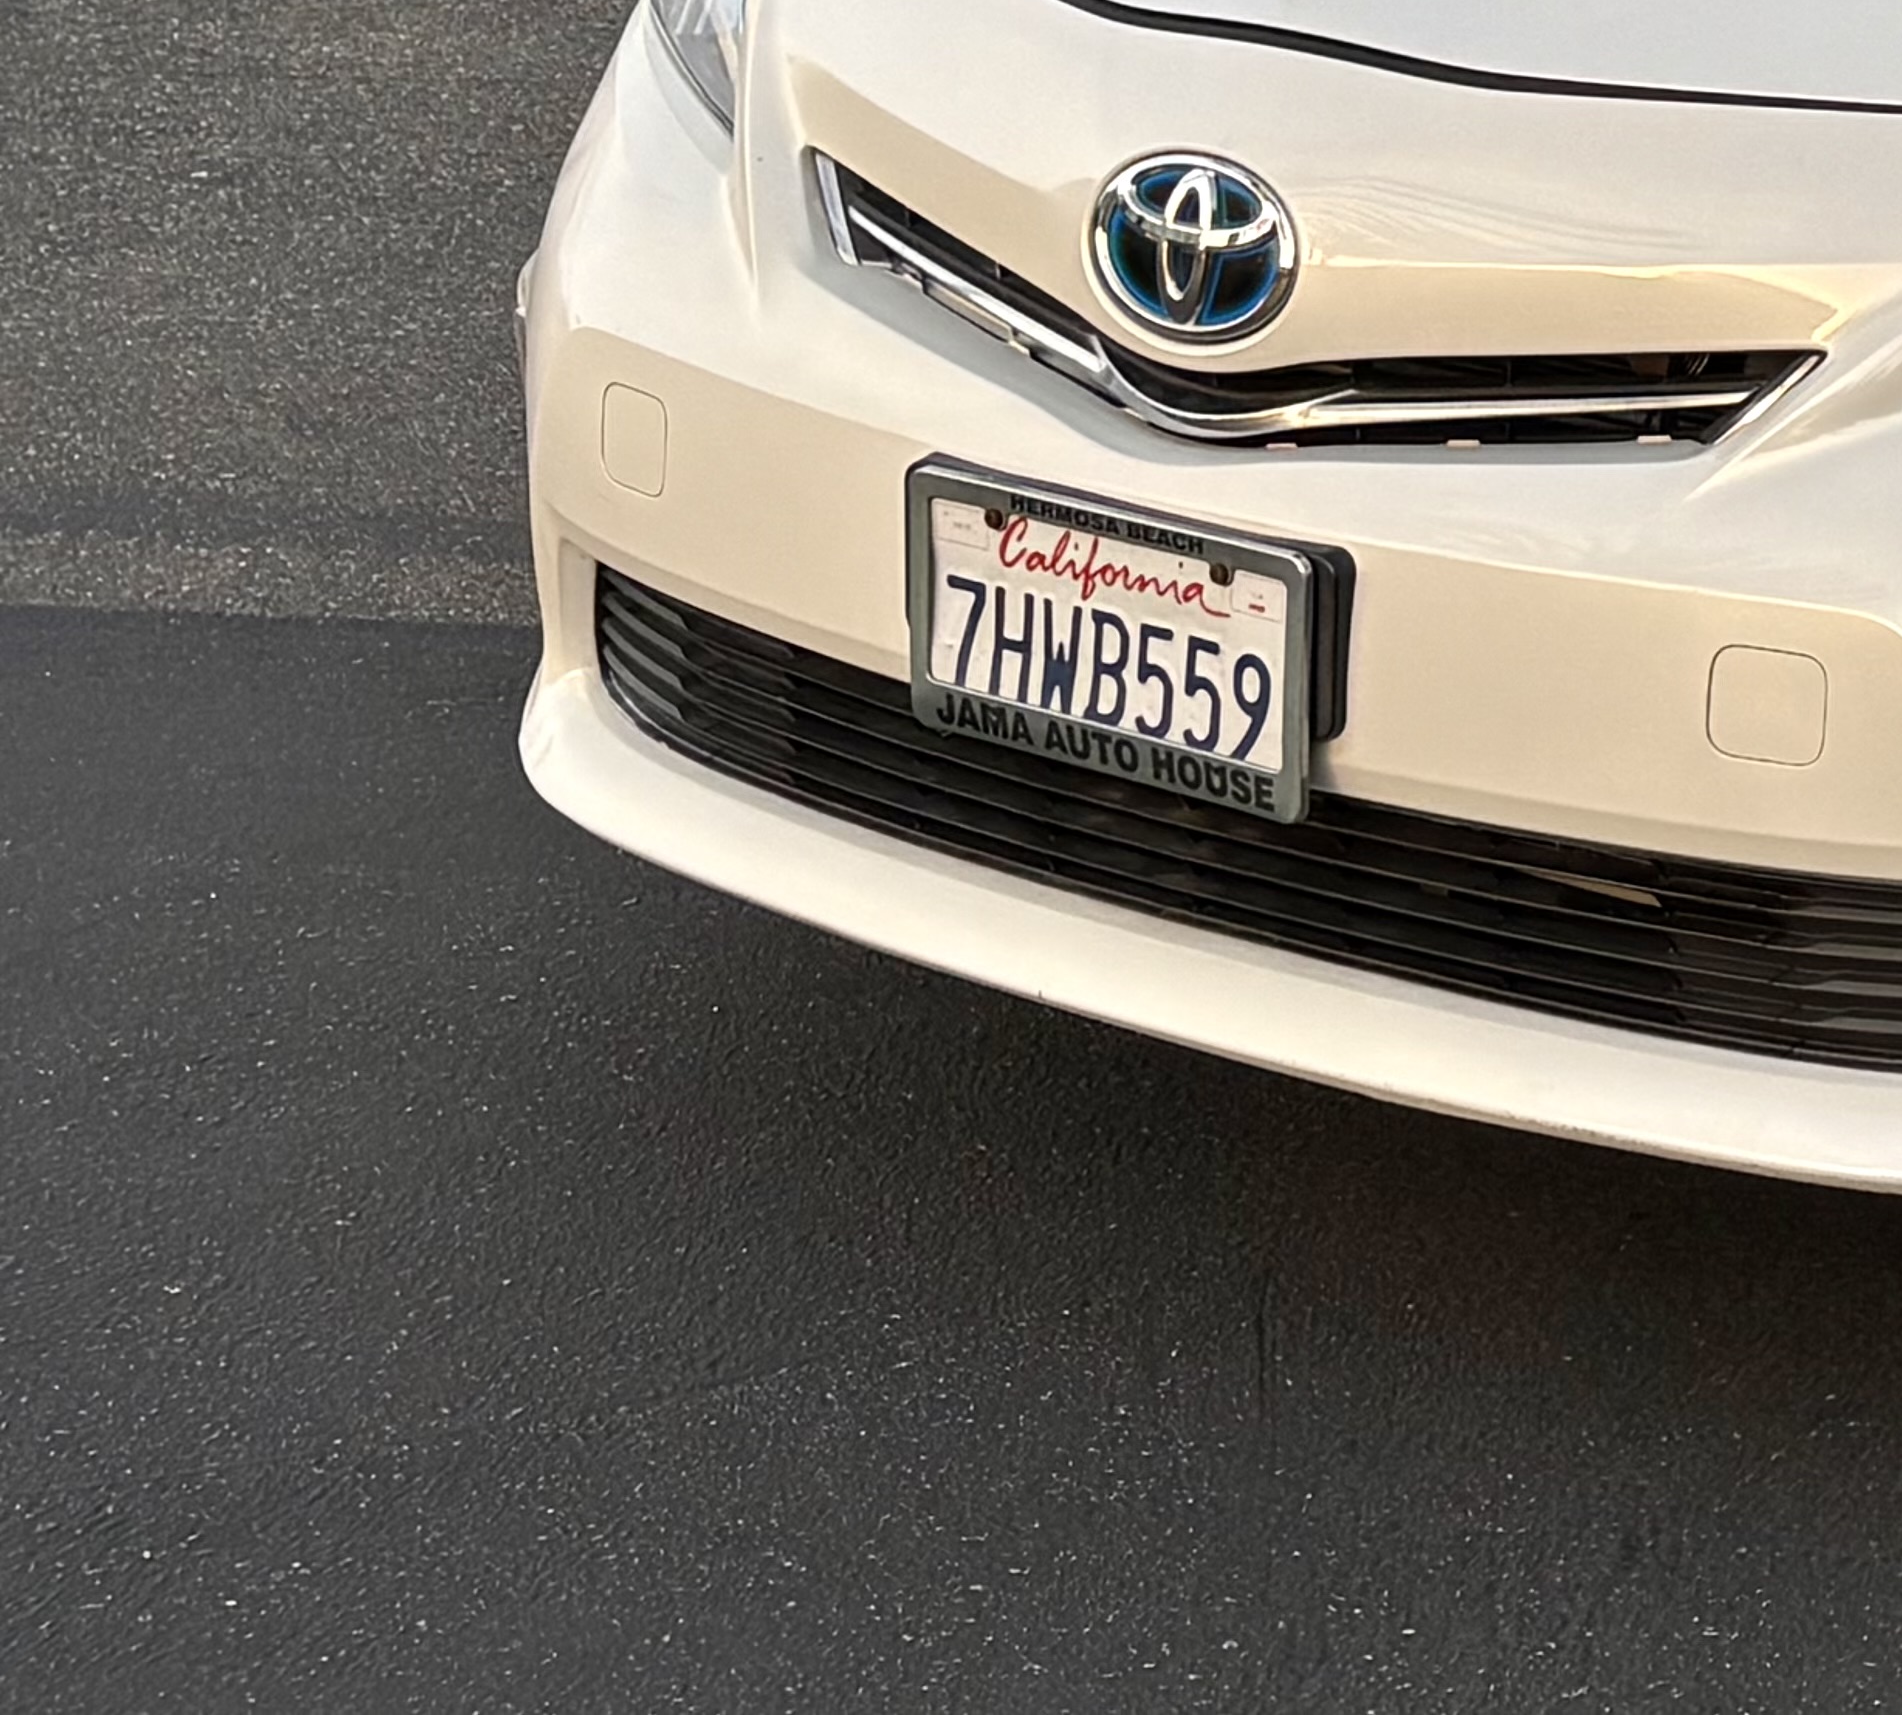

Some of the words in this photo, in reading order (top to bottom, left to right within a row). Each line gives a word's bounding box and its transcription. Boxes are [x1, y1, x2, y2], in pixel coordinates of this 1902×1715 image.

[998, 515, 1232, 619] California
[1009, 493, 1121, 536] HERMOSA
[1126, 520, 1206, 555] BEACH
[946, 573, 1272, 763] 7HWB559
[936, 692, 1035, 746] JAMA
[1045, 719, 1139, 774] AUTO
[1151, 746, 1276, 813] HOUSE
